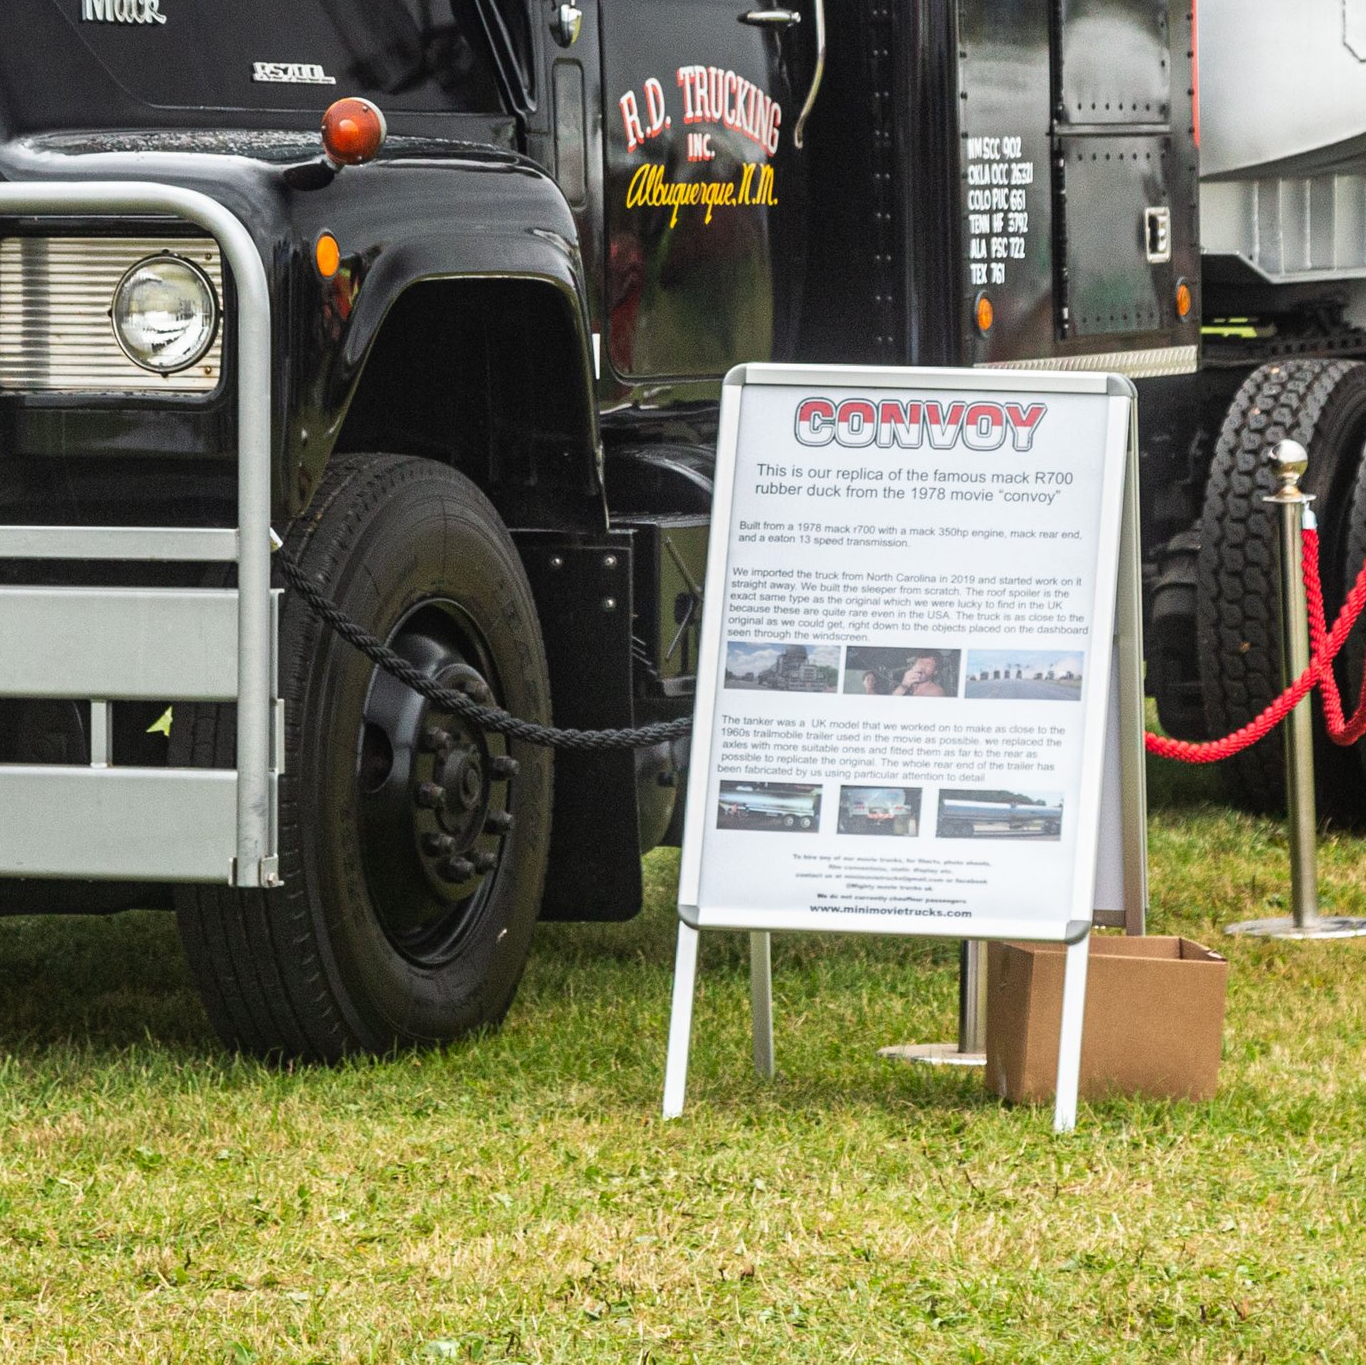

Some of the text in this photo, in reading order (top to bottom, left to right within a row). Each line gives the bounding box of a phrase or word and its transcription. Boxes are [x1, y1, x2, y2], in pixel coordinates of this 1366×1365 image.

[619, 65, 782, 157] R.D. TRUCKING
[688, 133, 715, 162] INC.
[968, 136, 1021, 160] NM SCC 902
[968, 164, 990, 185] OKLA
[991, 163, 1008, 184] OCC
[968, 188, 1025, 210] COLO PUC 661
[1007, 212, 1028, 234] 3792
[969, 237, 1025, 258] ALA PSC 722
[970, 263, 1005, 284] TEX 761
[794, 397, 1047, 452] CONVOY
[757, 463, 1073, 485] This is our replica of the famous mack R700
[755, 482, 1061, 506] rubber duck from the 1978 movie “convoy”
[738, 533, 757, 542] and
[767, 534, 796, 543] eaton
[798, 535, 812, 544] 13
[813, 535, 845, 547] speed
[739, 521, 761, 530] Built
[763, 521, 786, 531] from
[797, 522, 822, 532] 1978
[824, 523, 851, 533] mack
[853, 524, 877, 534] r700
[878, 525, 898, 534] with
[909, 526, 936, 536] mack
[938, 527, 969, 539] 350hp
[1010, 529, 1037, 539] mack
[1039, 532, 1059, 540] rear
[733, 567, 749, 577] We
[750, 568, 794, 581] imported
[796, 569, 813, 579] the
[815, 570, 840, 580] truck
[841, 571, 864, 580] from
[865, 572, 893, 581] North
[896, 572, 937, 583] Carolina
[939, 574, 948, 583] in
[950, 574, 976, 584] 2019
[977, 575, 997, 584] and
[999, 576, 1033, 586] started
[1035, 577, 1059, 586] work
[1076, 578, 1082, 587] it
[731, 579, 768, 592] straight
[800, 582, 818, 591] We
[819, 582, 841, 592] built
[842, 583, 859, 592] the
[861, 583, 898, 596] sleeper
[900, 585, 922, 594] from
[964, 587, 984, 596] The
[986, 587, 1007, 597] roof
[1008, 588, 1041, 600] spoiler
[1043, 589, 1052, 598] is
[1053, 589, 1070, 599] the
[730, 592, 757, 601] exact
[789, 594, 811, 605] type
[827, 594, 844, 604] the
[845, 595, 881, 608] original
[882, 596, 912, 606] which
[957, 598, 983, 611] lucky
[985, 600, 995, 608] to
[996, 600, 1016, 609] find
[1017, 600, 1027, 610] in
[1028, 601, 1045, 610] the
[1047, 601, 1063, 611] UK
[721, 727, 751, 737] 1960s
[753, 728, 804, 739] trailmobile
[805, 730, 835, 740] trailer
[836, 731, 861, 740] used
[863, 732, 872, 741] in
[873, 732, 890, 741] the
[892, 732, 923, 742] movie
[1001, 736, 1044, 749] replaced
[1045, 737, 1062, 747] the
[717, 763, 742, 773] been
[744, 764, 794, 775] fabricated
[796, 766, 808, 778] by
[824, 767, 852, 779] using
[854, 768, 900, 781] particular
[901, 769, 945, 780] attention
[946, 771, 957, 780] to
[958, 771, 985, 781] detail
[809, 904, 972, 918] www.minimovietrucks.com
